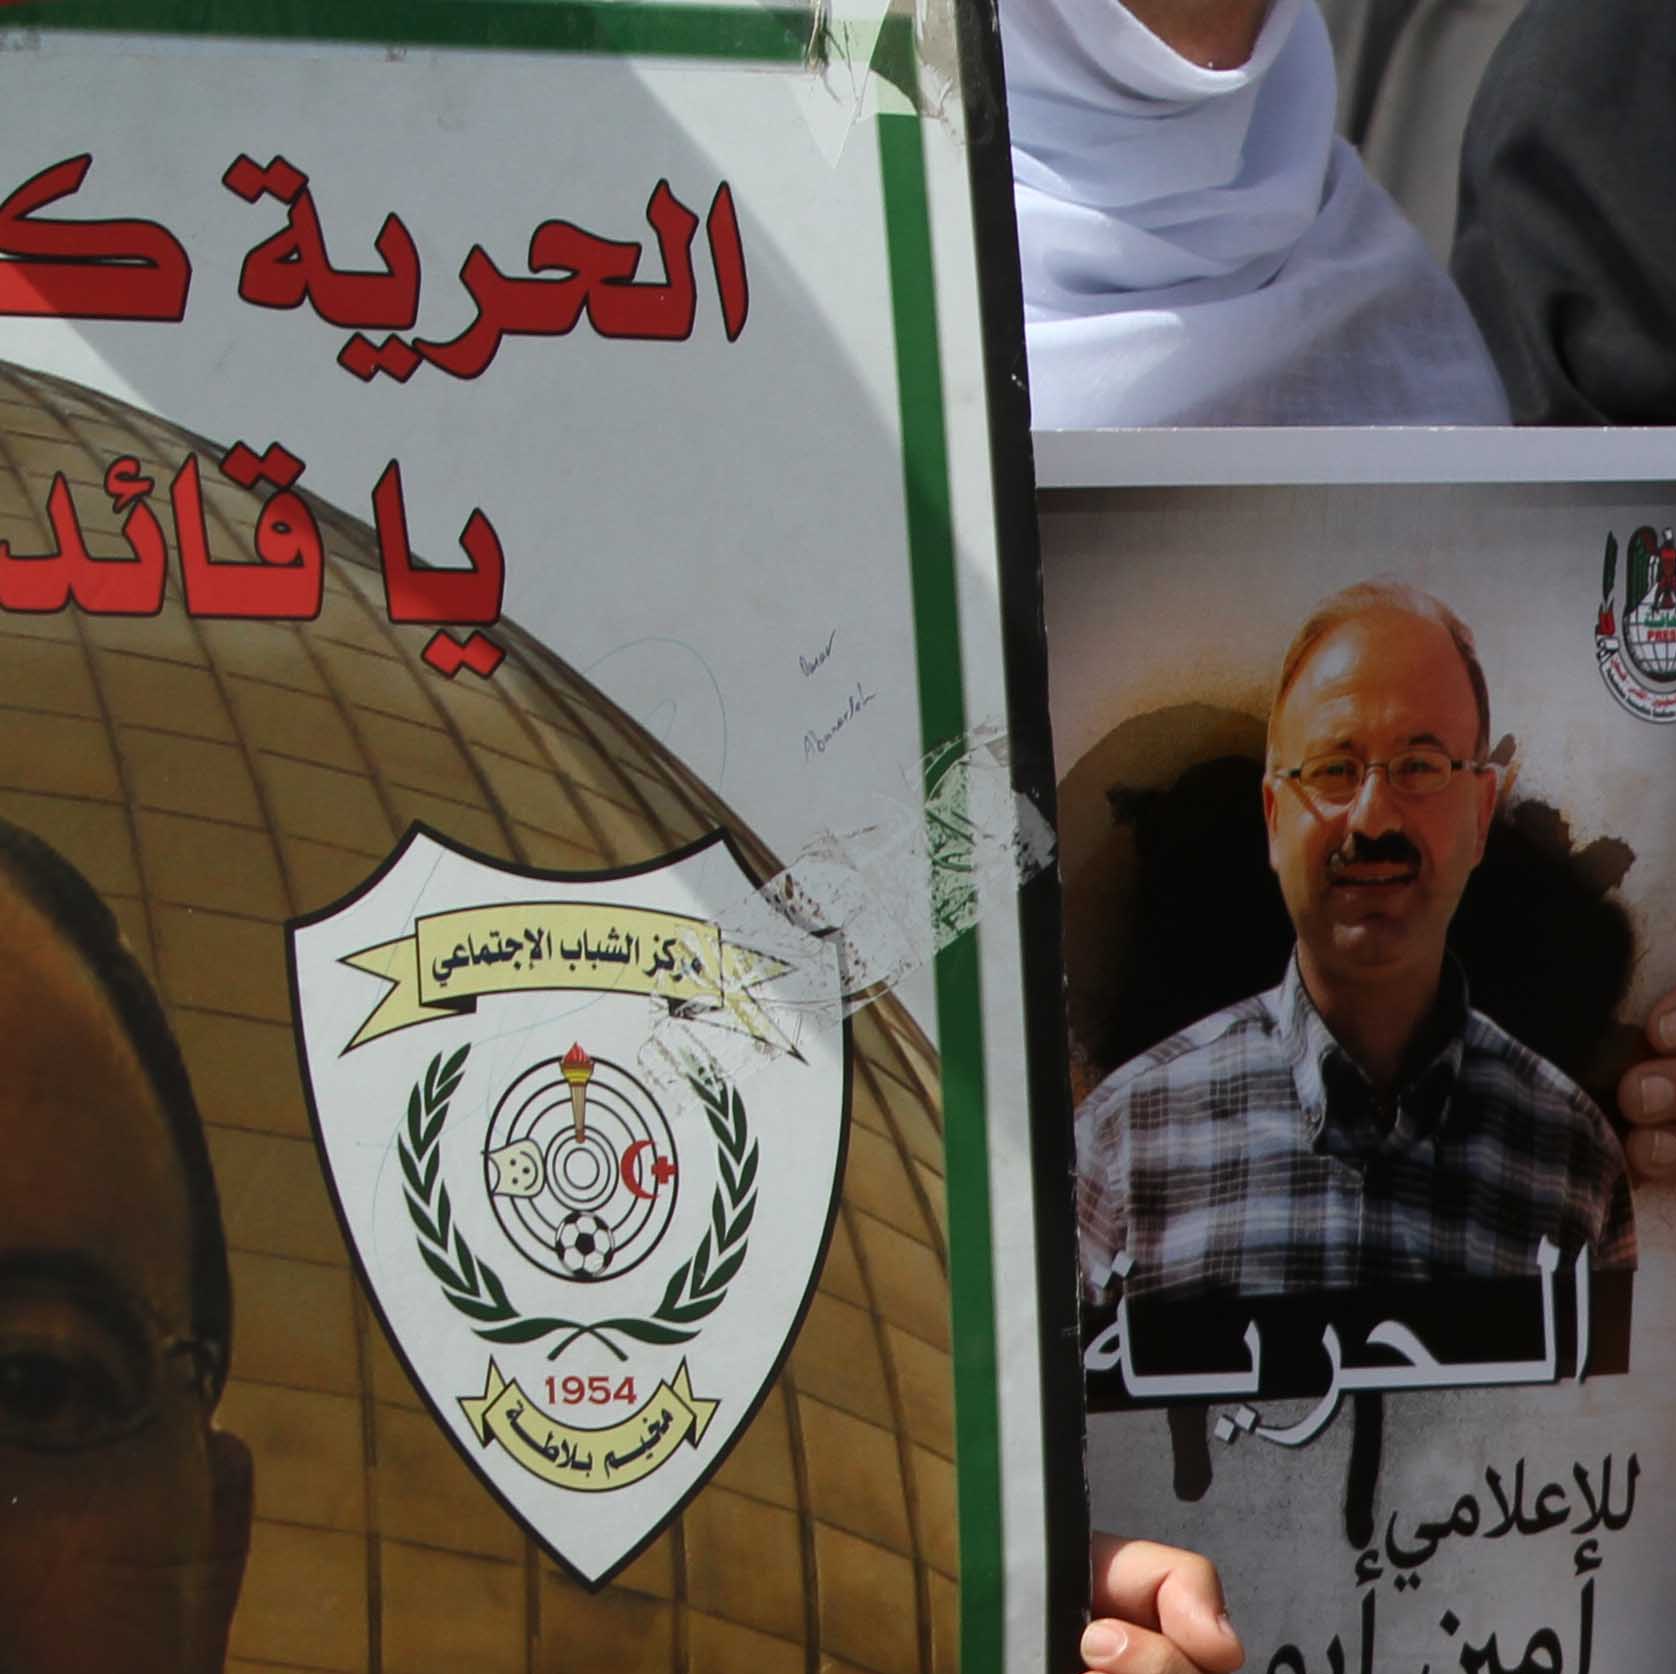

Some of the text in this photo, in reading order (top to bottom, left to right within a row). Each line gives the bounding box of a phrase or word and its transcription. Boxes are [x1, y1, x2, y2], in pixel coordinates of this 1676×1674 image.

[222, 153, 748, 381] الحرية
[370, 459, 505, 679] يا
[430, 927, 552, 986] الإجتماعي
[560, 926, 640, 971] الشباب
[1084, 1233, 1590, 1449] الحرية
[545, 1375, 637, 1406] 1954
[603, 1409, 674, 1478] مخيم
